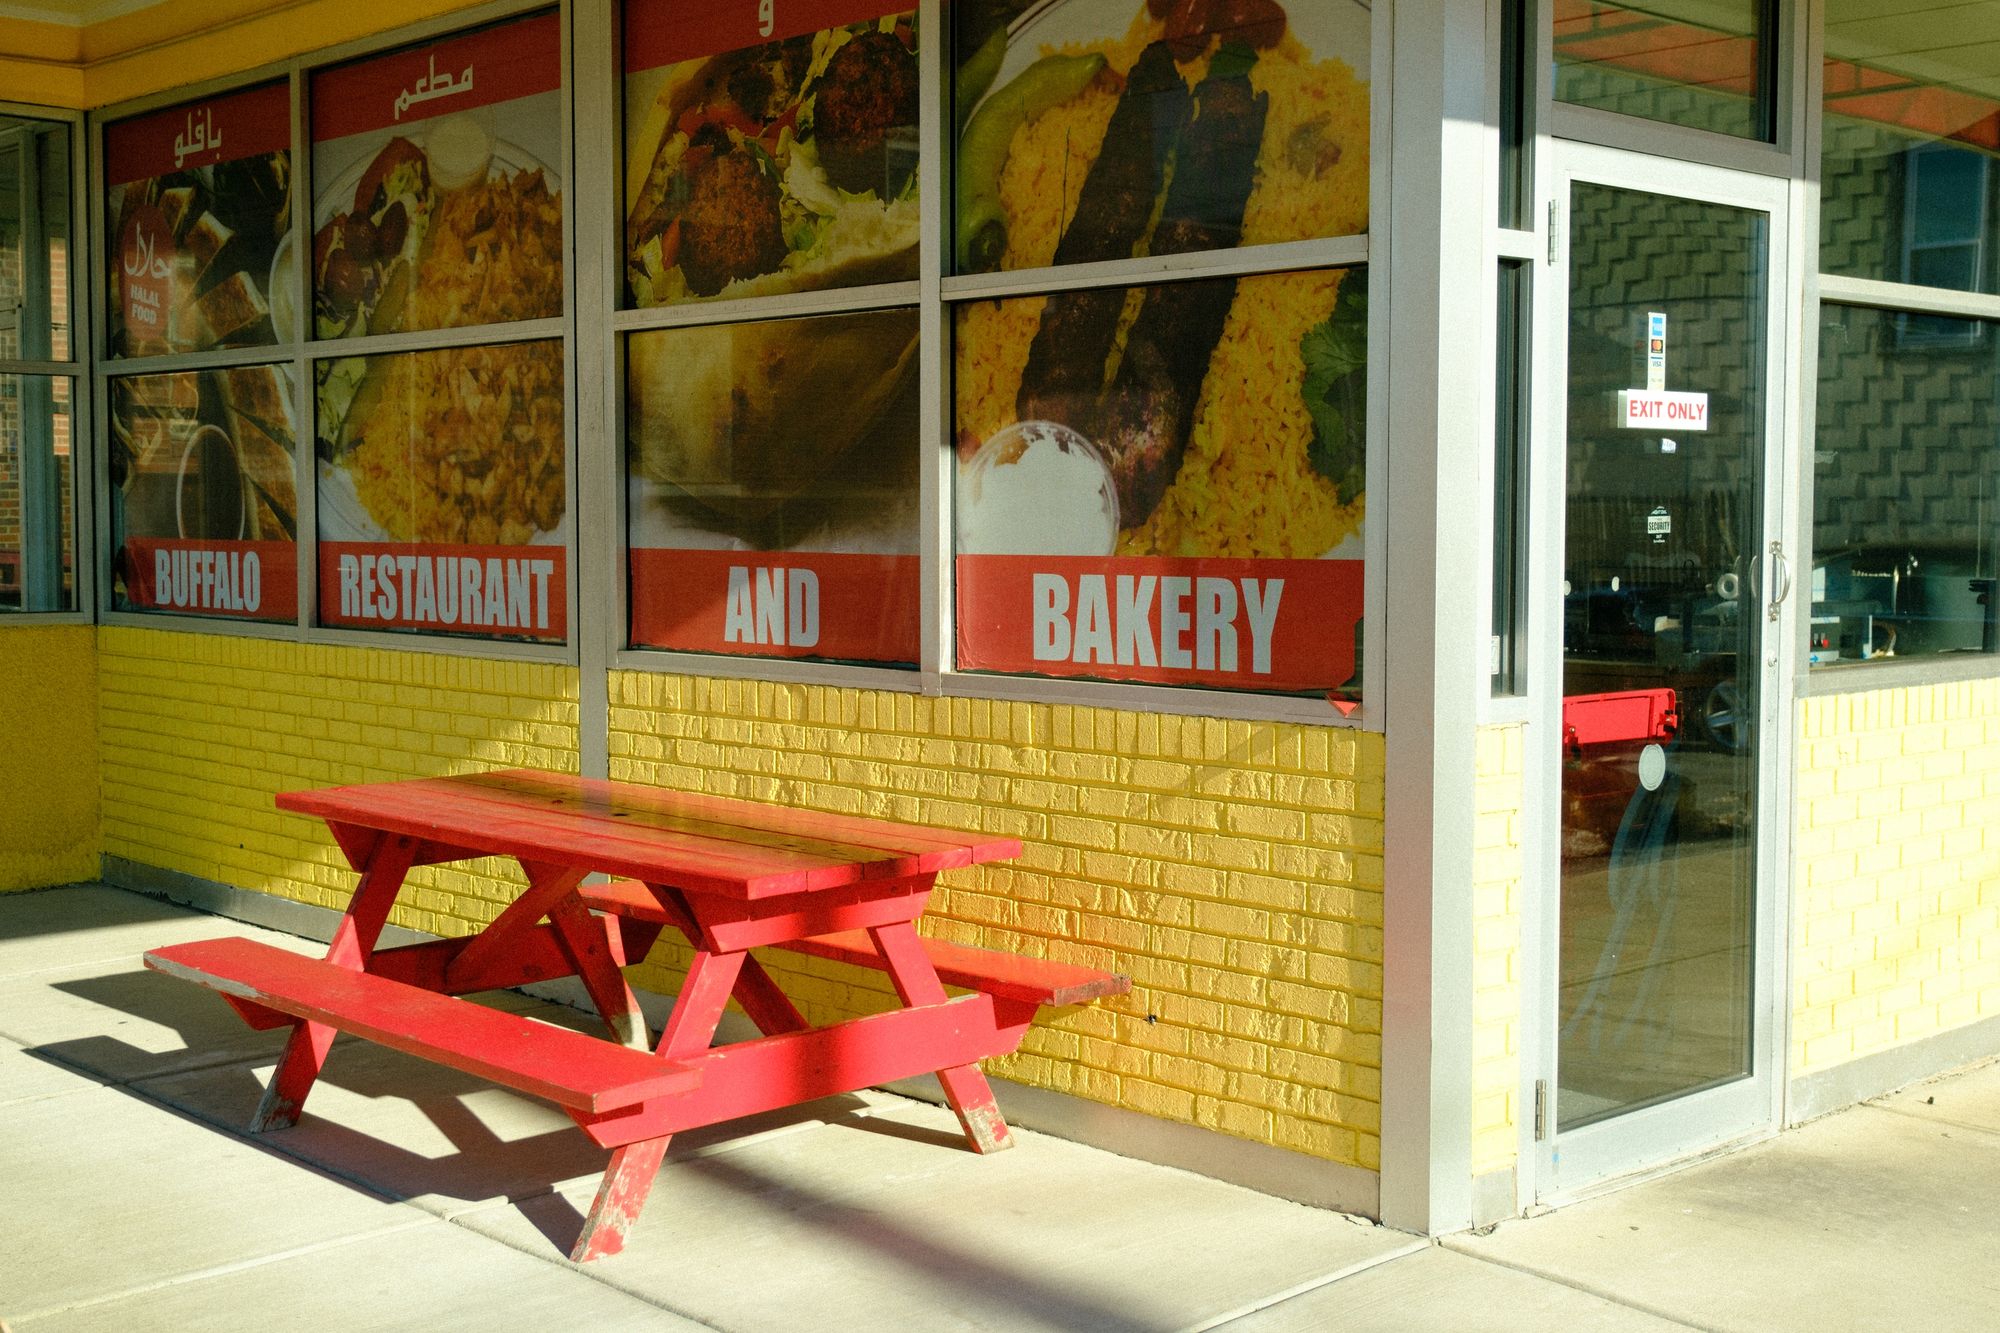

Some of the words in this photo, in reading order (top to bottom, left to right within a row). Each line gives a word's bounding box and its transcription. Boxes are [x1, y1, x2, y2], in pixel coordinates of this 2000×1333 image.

[394, 54, 473, 120] مطعم
[174, 107, 222, 168] بافلو
[124, 221, 171, 279] حلال
[130, 284, 160, 308] HALAL
[132, 303, 157, 325] FOOD
[1629, 400, 1663, 418] EXIT
[1667, 401, 1705, 421] ONLY
[1648, 521, 1670, 531] SECURITY
[154, 549, 261, 612] BUFFALO
[340, 554, 554, 630] RESTAURANT
[724, 566, 820, 648] AND
[1032, 573, 1285, 675] BAKERY
